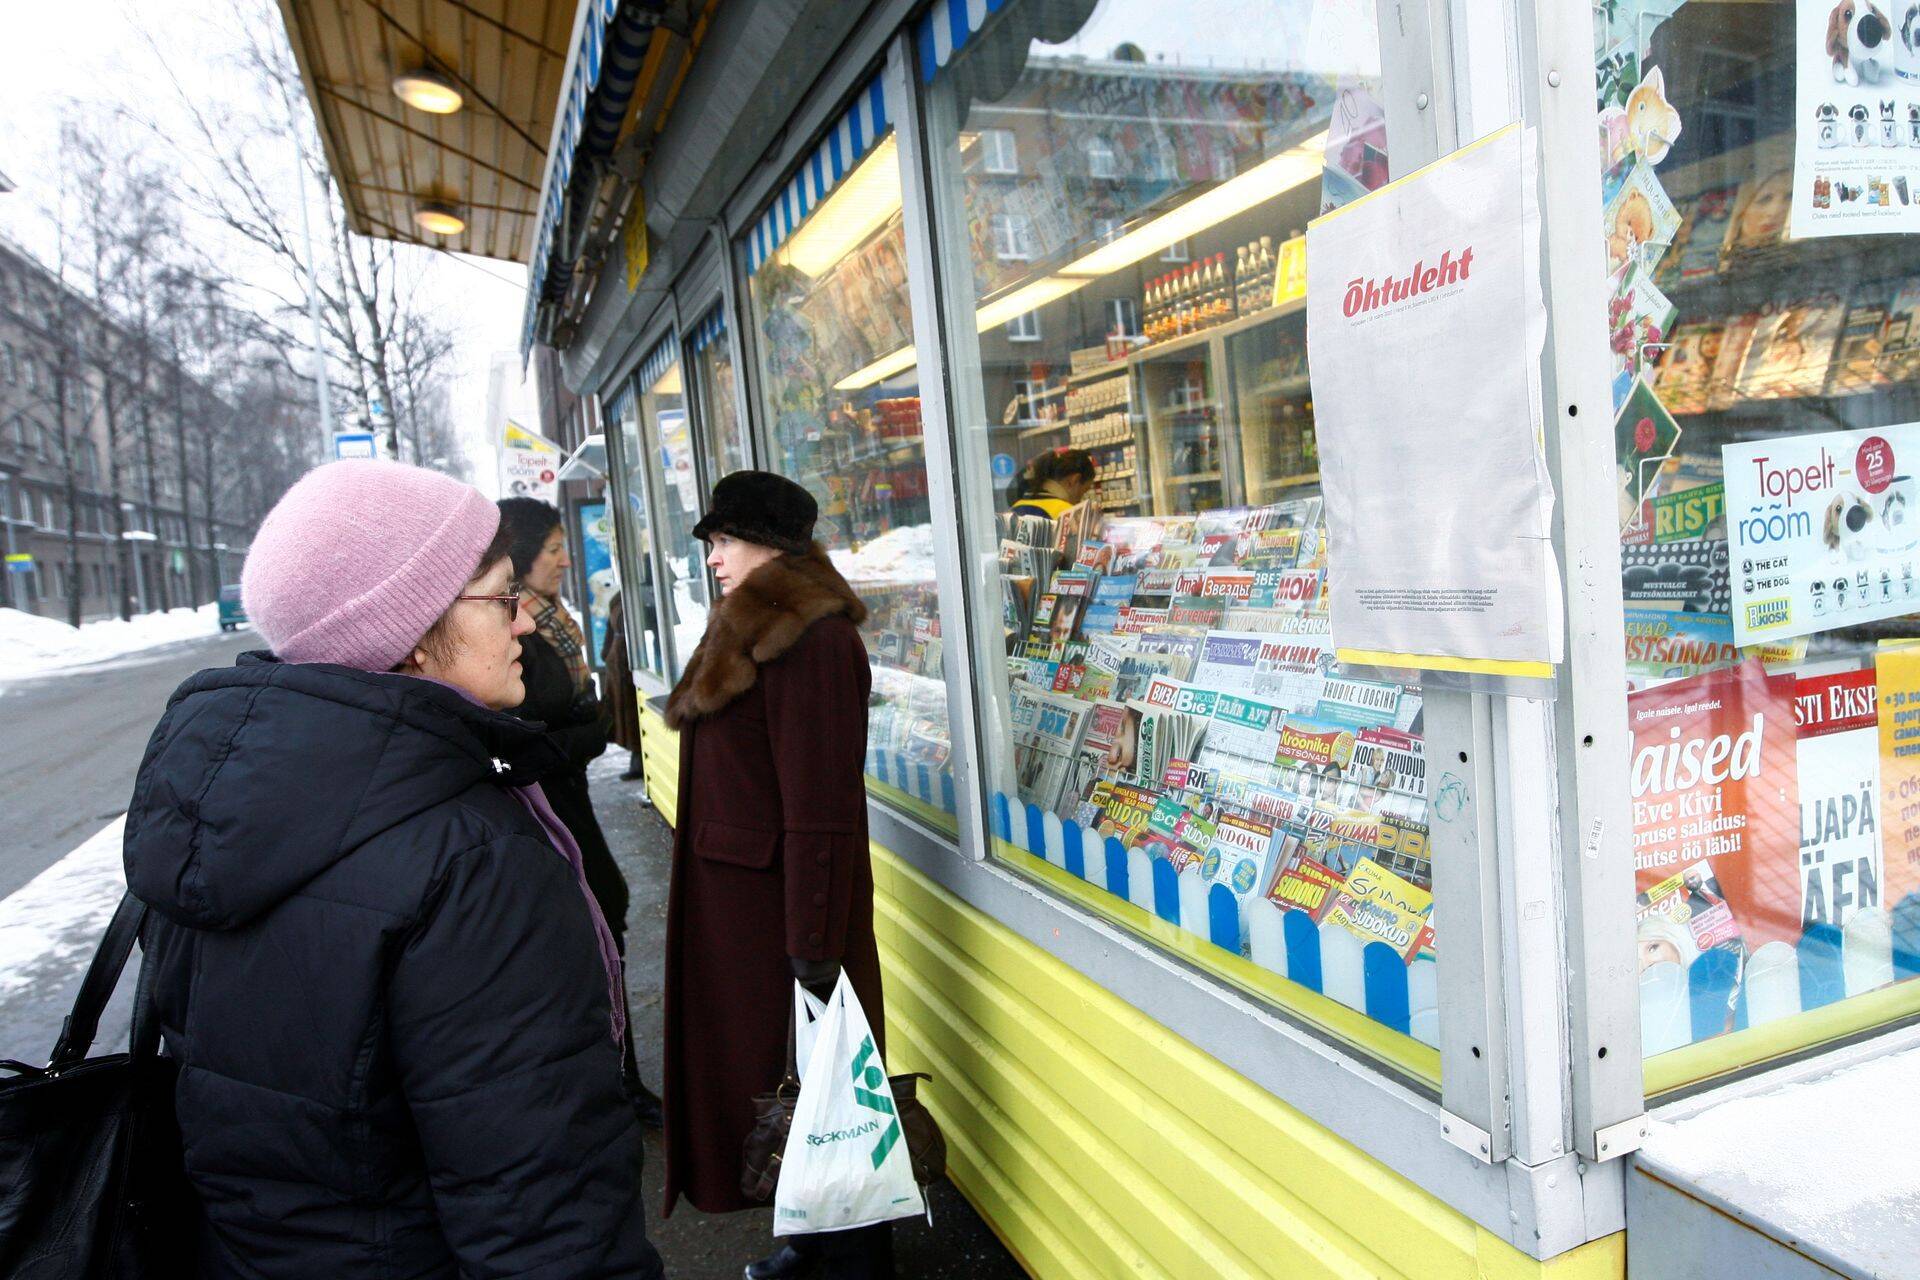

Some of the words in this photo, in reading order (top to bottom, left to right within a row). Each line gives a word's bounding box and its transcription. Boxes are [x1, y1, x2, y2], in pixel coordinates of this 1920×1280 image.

[1342, 245, 1474, 318] Õhtuleht
[1866, 450, 1884, 471] 25
[1739, 503, 1811, 546] rõõm
[1756, 560, 1771, 571] THE
[1773, 558, 1788, 569] CAT
[1204, 578, 1251, 597] Звезды
[1757, 580, 1772, 590] THE
[1774, 577, 1790, 588] DOG
[1759, 611, 1789, 626] KIOSK
[1260, 643, 1322, 665] ПИКНИК
[1176, 690, 1207, 713] BIG
[1636, 710, 1655, 720] Igale
[1656, 706, 1683, 717] naisele.
[1684, 703, 1698, 715] Igal
[1698, 700, 1722, 711] reedel.
[1278, 746, 1328, 763] RISTSÕNAD
[1282, 730, 1331, 755] Kroonika
[1385, 752, 1426, 779] RUUDUD
[1629, 713, 1764, 798] aised
[1633, 800, 1673, 826] Eve
[1678, 786, 1723, 818] Kivi
[1680, 813, 1746, 839] saladus:
[1681, 841, 1702, 861] öö
[1705, 832, 1742, 857] läbi!
[1274, 874, 1326, 910] SUDOKU
[1352, 908, 1410, 947] SUDOKUD
